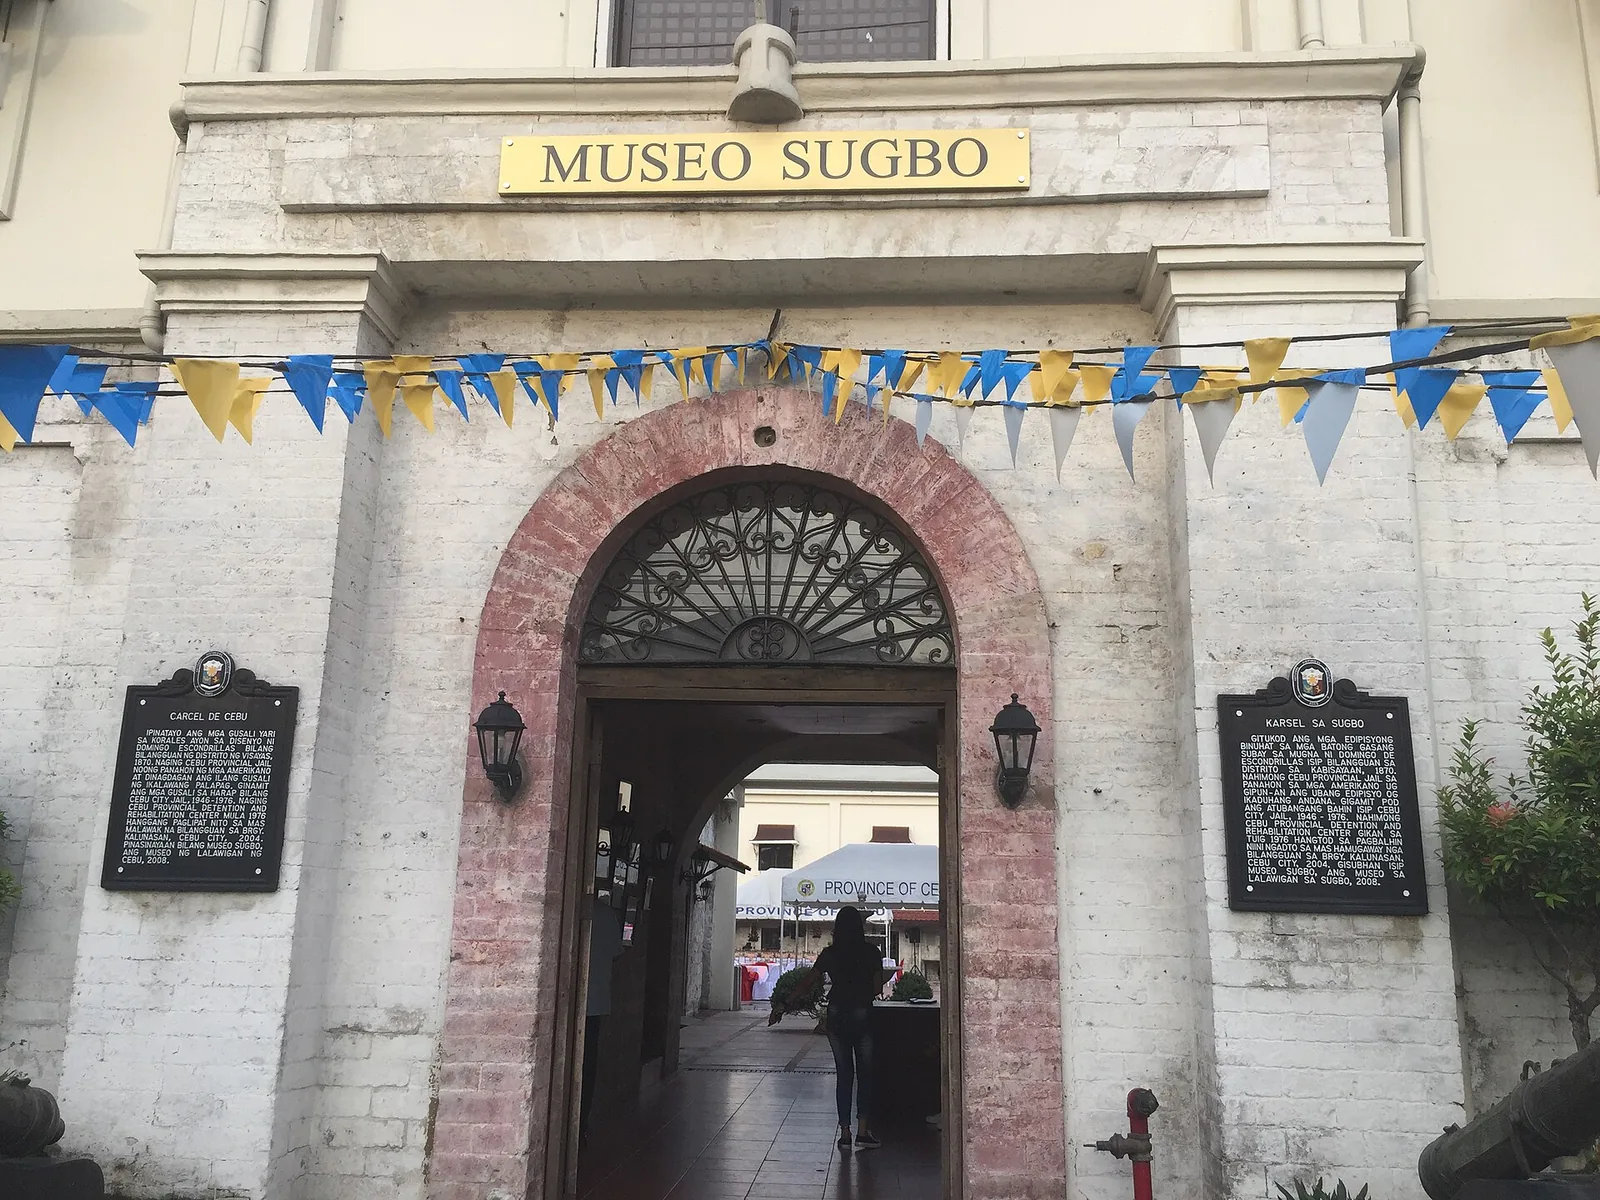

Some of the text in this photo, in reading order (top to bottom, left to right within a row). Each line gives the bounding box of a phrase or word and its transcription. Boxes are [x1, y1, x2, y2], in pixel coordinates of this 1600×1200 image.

[540, 137, 989, 183] MUSEO SUGBO
[169, 712, 205, 720] CARCEL
[224, 713, 248, 721] CEBU
[1266, 719, 1364, 728] KARSEL SA SUGBO
[178, 744, 236, 752] ESCONDRILLAS
[1240, 742, 1274, 750] BINUHAT
[1321, 743, 1354, 751] BATONG
[1338, 751, 1377, 759] DOMINGO
[1241, 757, 1304, 766] ESCONDRILLAS
[1327, 759, 1381, 767] BILANGGUAN
[1242, 765, 1279, 773] DISTRITO
[1242, 773, 1286, 781] NAHIMONG
[1312, 774, 1361, 782] PROVINCIAL
[1331, 782, 1380, 790] AMERIKANO
[1345, 790, 1382, 798] EDIPISYO
[1244, 796, 1292, 804] IKADUHANG
[201, 804, 246, 812] DETENTION
[1377, 806, 1400, 814] CEBU
[1274, 820, 1323, 828] PROVINCIAL
[1330, 821, 1378, 829] DETENTION
[1246, 828, 1311, 836] REHABILITATION
[1317, 829, 1351, 837] CENTER
[1247, 835, 1266, 843] TUIG
[1294, 836, 1334, 844] HANGTOD
[1356, 838, 1403, 846] PAGBALHIN
[1333, 845, 1384, 853] HAMUGAWAY
[1247, 851, 1302, 859] BILANGGUAN
[1247, 859, 1270, 867] CEBU
[1337, 860, 1381, 869] GISUBHAN
[1388, 861, 1405, 870] ISIP
[1248, 867, 1277, 875] MUSEO
[1248, 875, 1298, 883] LALAWIGAN
[824, 881, 895, 896] PROVINCE
[899, 882, 916, 896] OF
